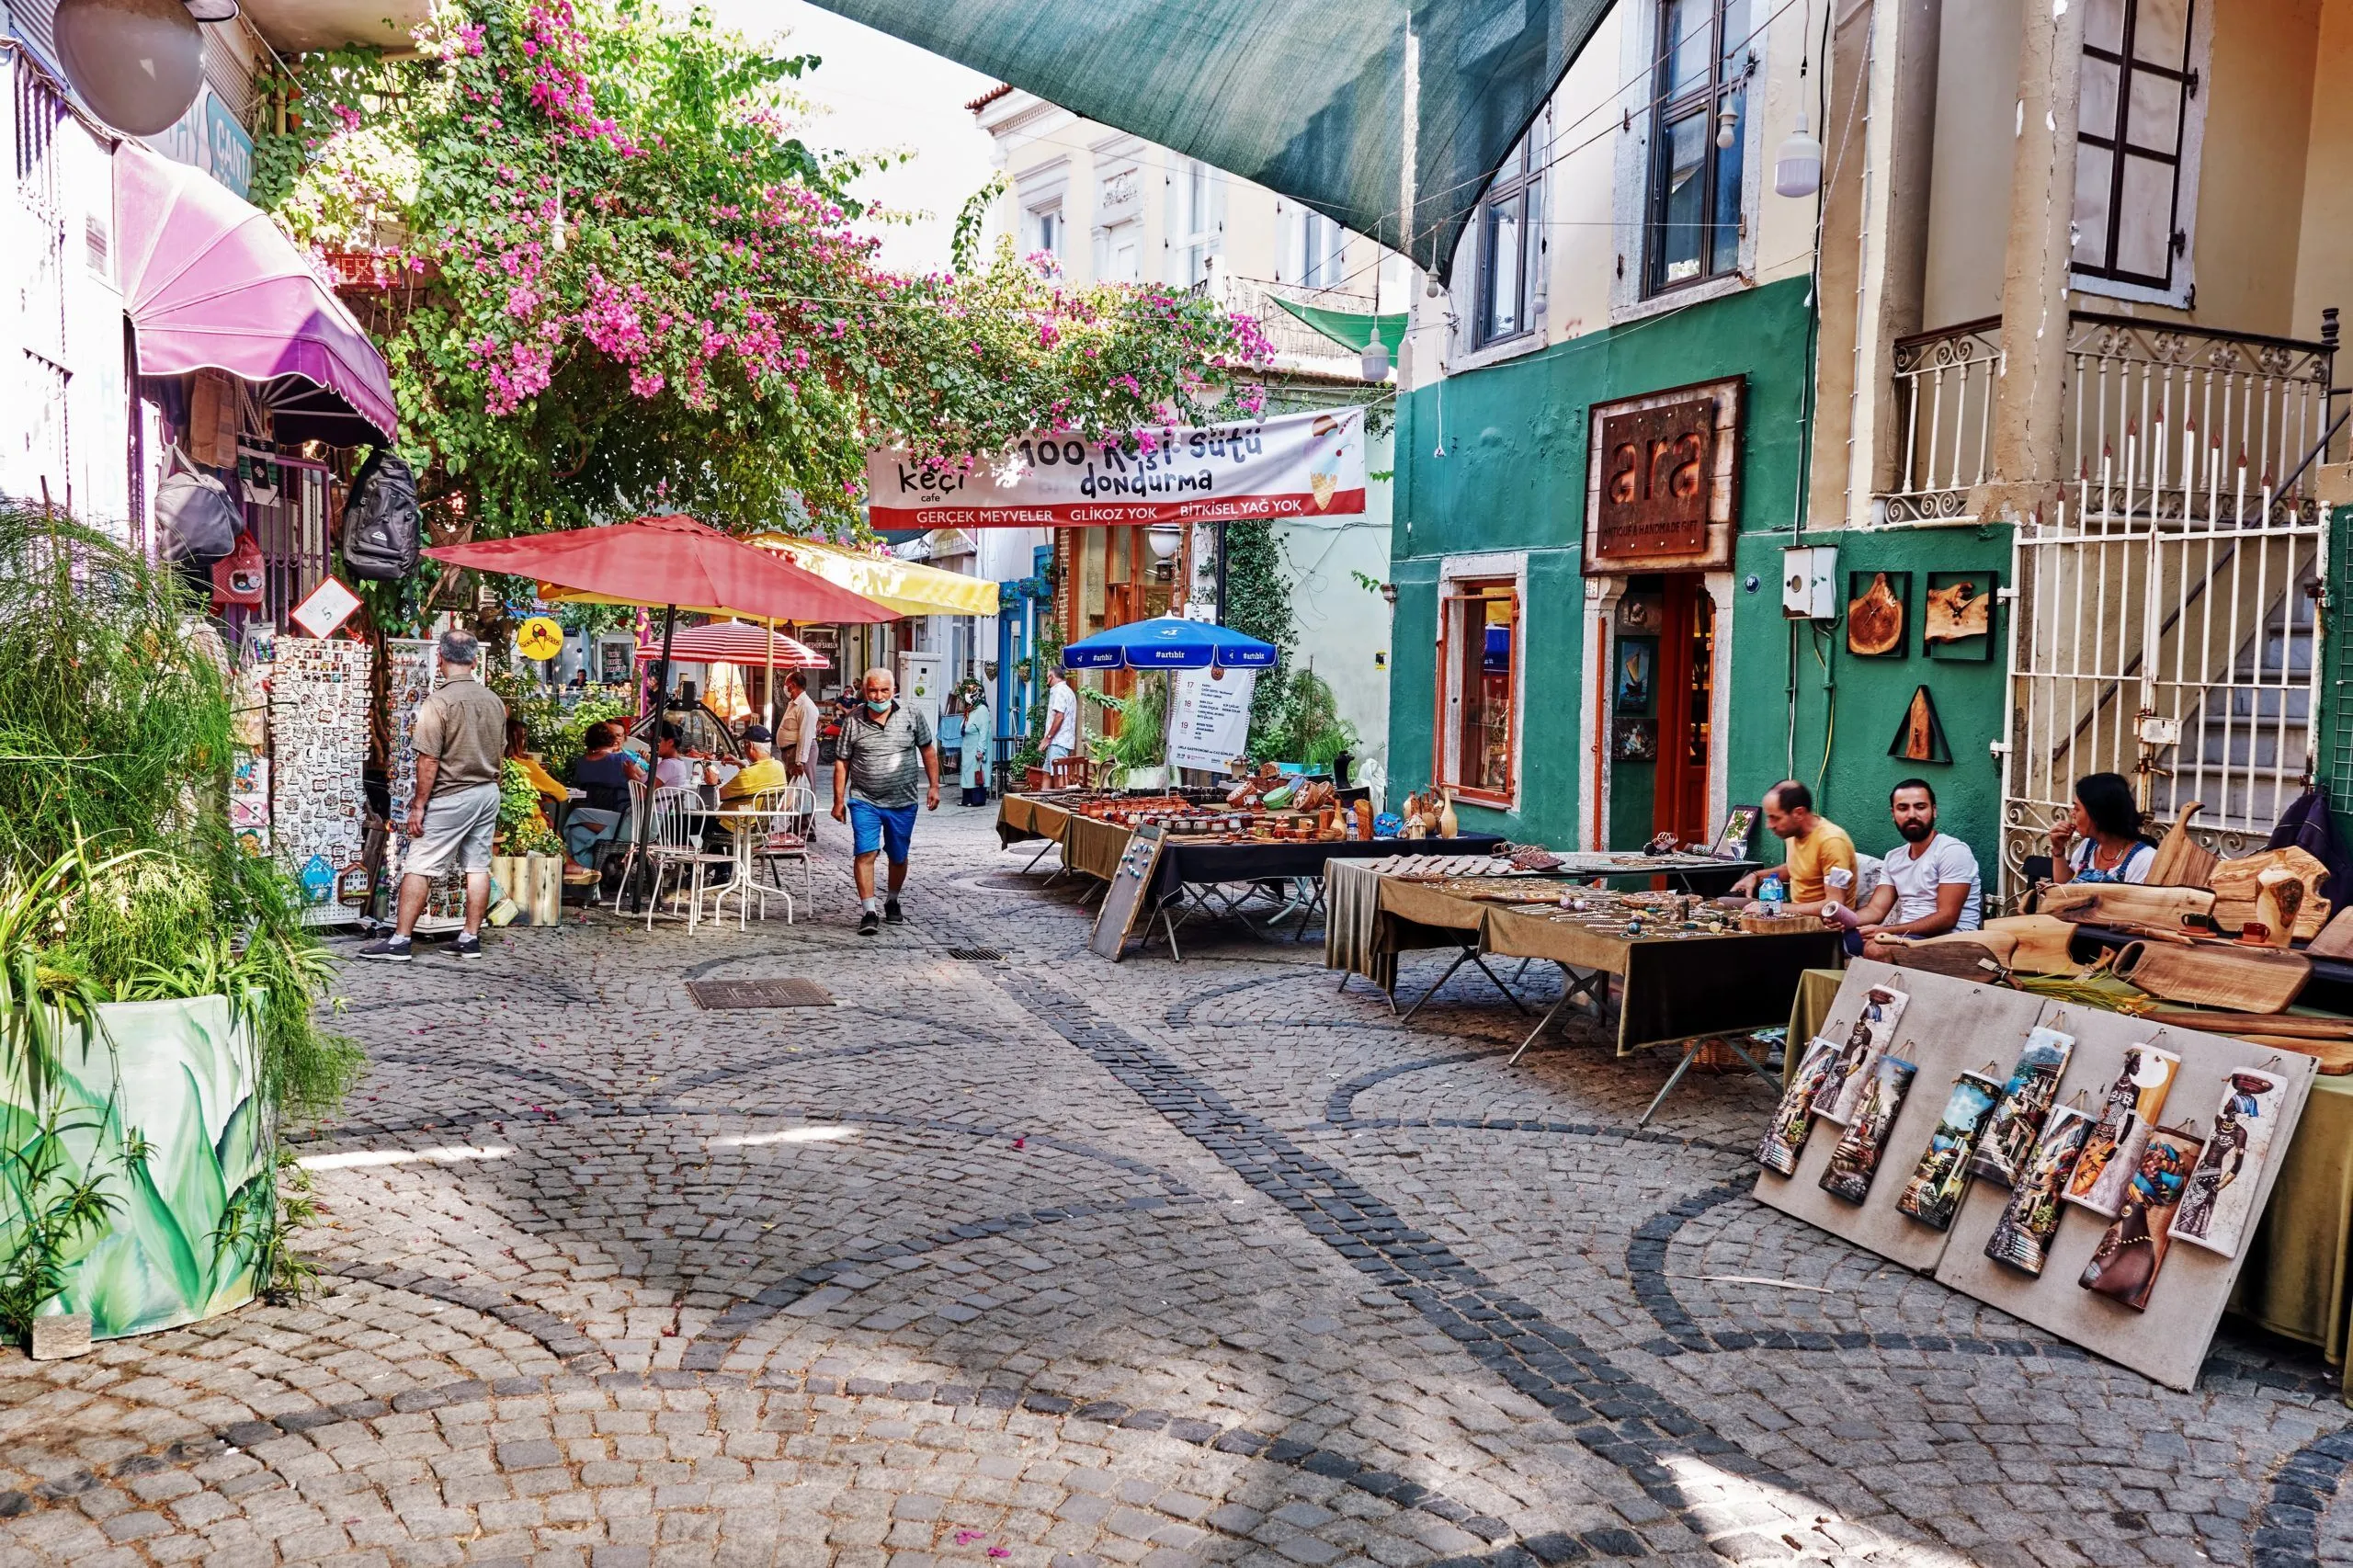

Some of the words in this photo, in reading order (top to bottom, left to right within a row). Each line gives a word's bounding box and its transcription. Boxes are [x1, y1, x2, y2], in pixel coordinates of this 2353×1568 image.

[898, 463, 968, 494] keçi
[1608, 432, 1700, 505] ara
[916, 511, 975, 525] GERÇEK
[980, 510, 1053, 522] MEYVELER
[1070, 506, 1124, 521] GLİKOZ
[1128, 506, 1157, 519] YOK
[1180, 502, 1238, 517] BİTKİSEL
[1240, 498, 1269, 514] YAĞ
[1272, 500, 1302, 512] YOK
[921, 494, 940, 502] cafe
[1639, 521, 1680, 535] HANDMADE
[1681, 520, 1699, 532] GIFT
